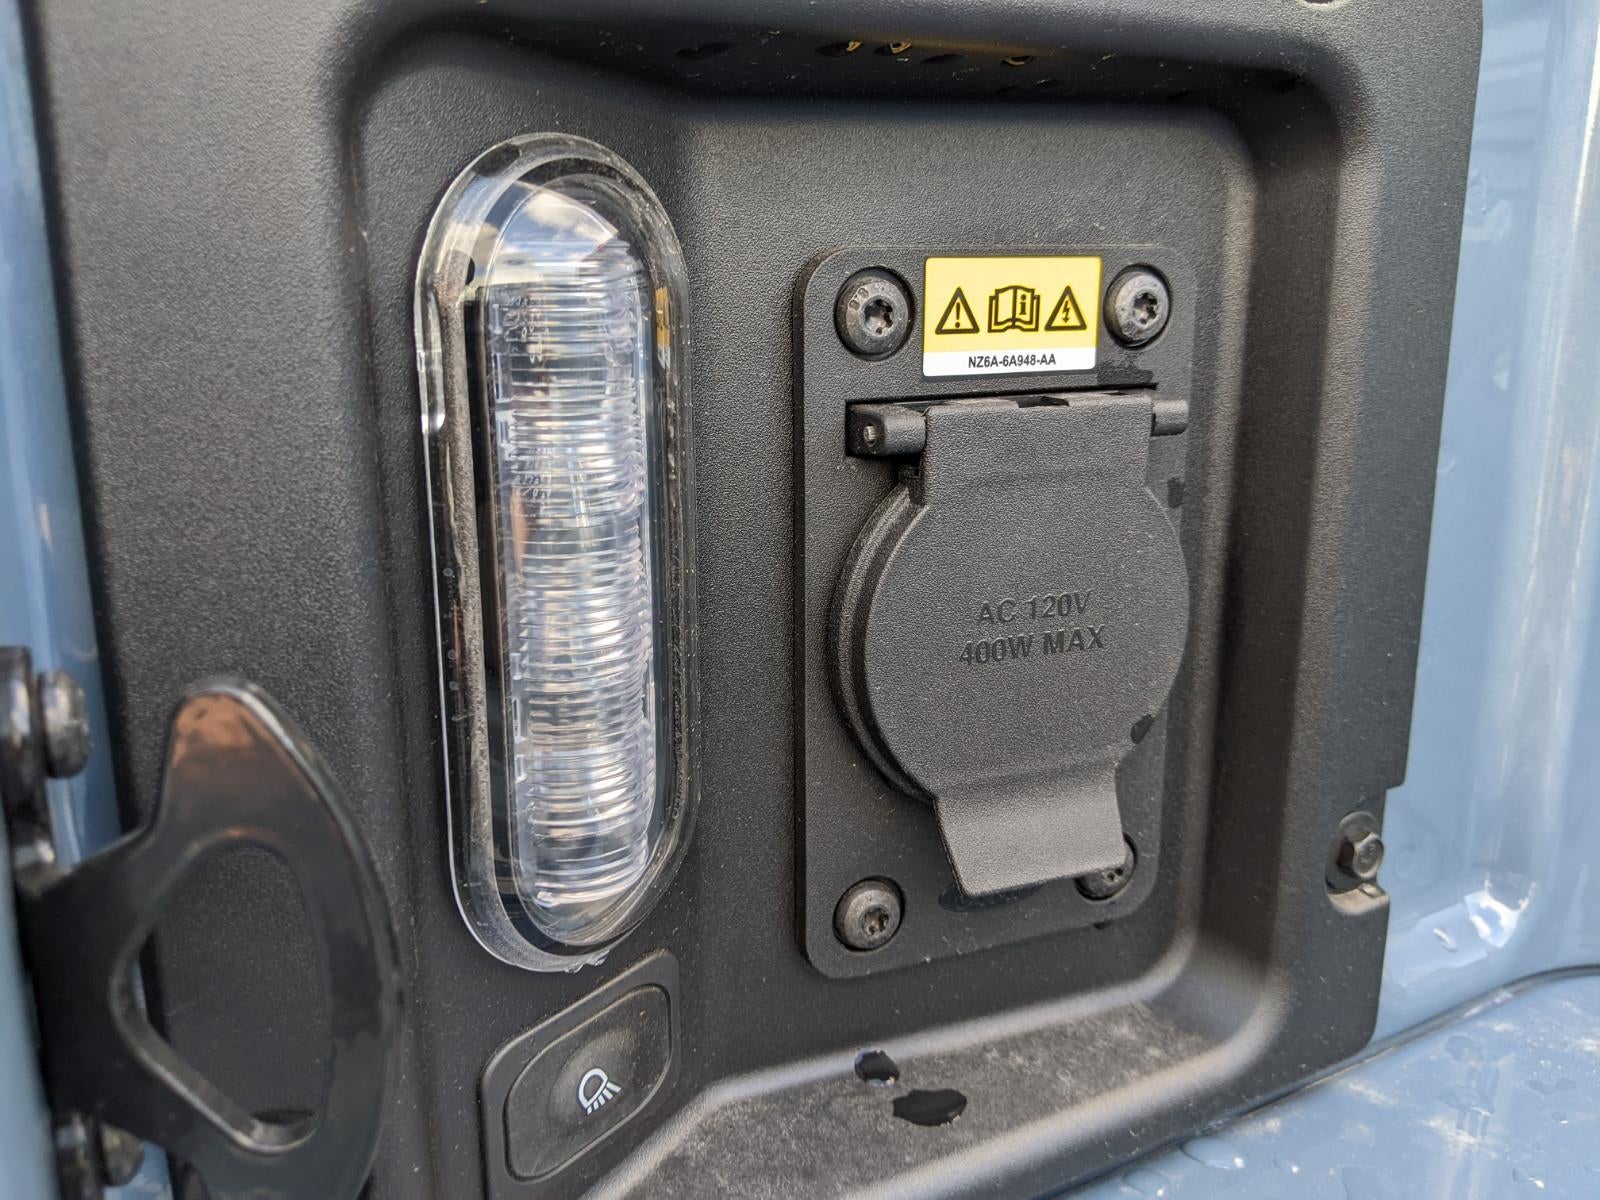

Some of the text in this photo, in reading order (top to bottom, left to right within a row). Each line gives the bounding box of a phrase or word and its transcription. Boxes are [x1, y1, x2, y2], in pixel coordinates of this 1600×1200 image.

[968, 354, 1057, 368] NZ6A-6A948-AA
[979, 588, 1093, 624] AC 120V
[960, 624, 1106, 665] 400W MAX
